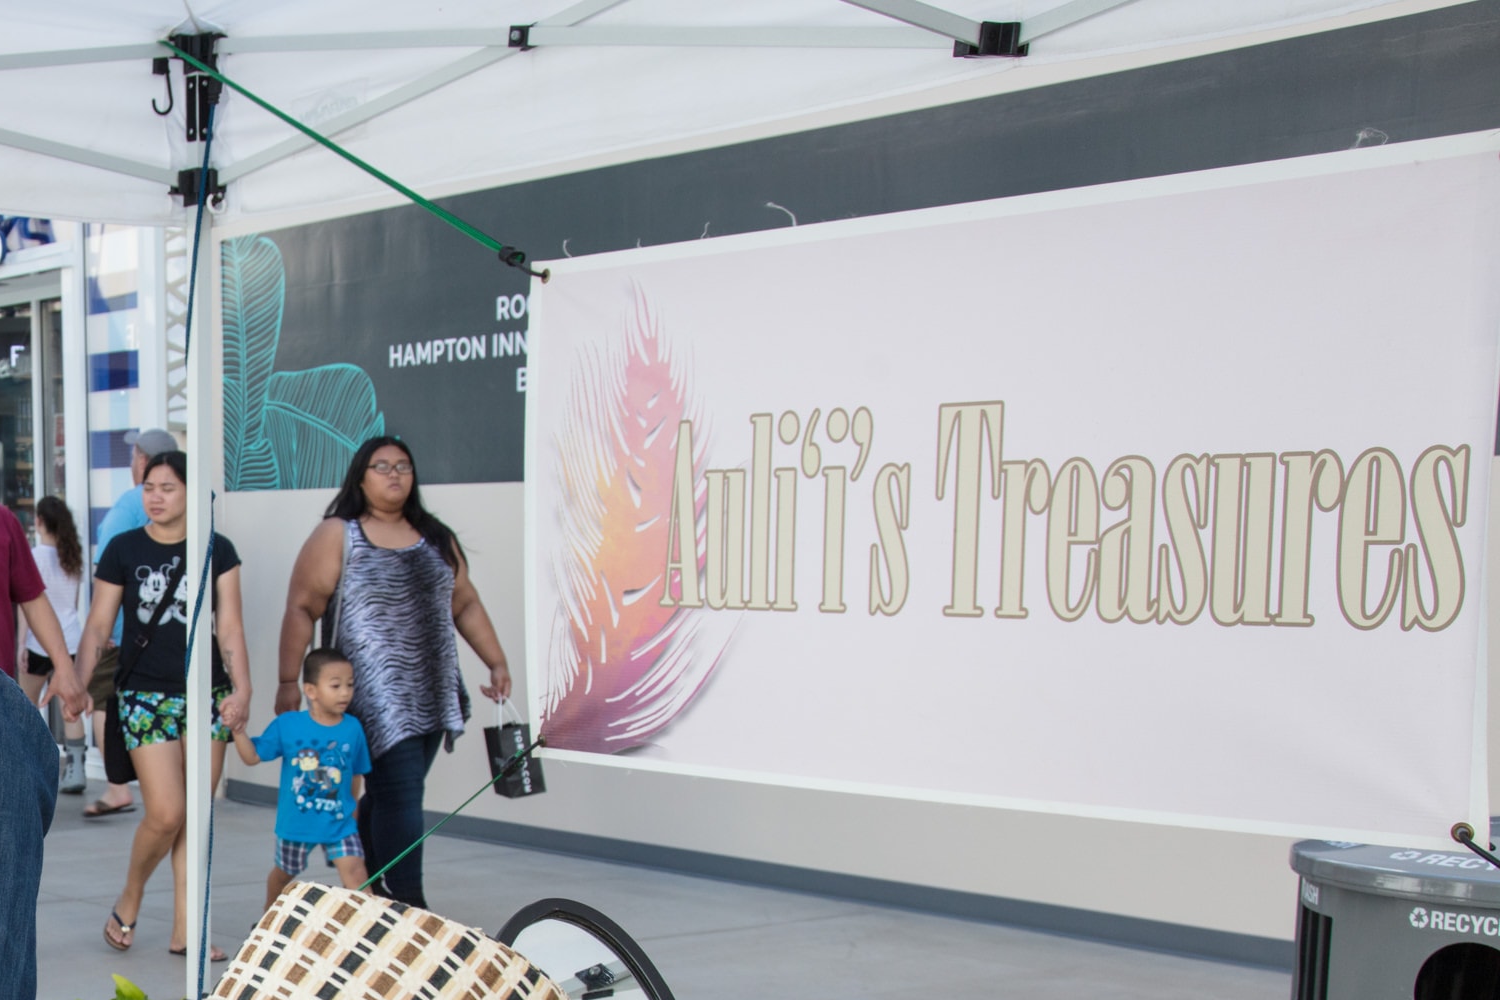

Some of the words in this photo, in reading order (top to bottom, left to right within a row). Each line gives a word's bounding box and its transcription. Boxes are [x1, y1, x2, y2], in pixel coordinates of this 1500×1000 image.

[389, 334, 486, 368] HAMPTON
[492, 330, 529, 358] INN
[935, 400, 1472, 632] Treasures
